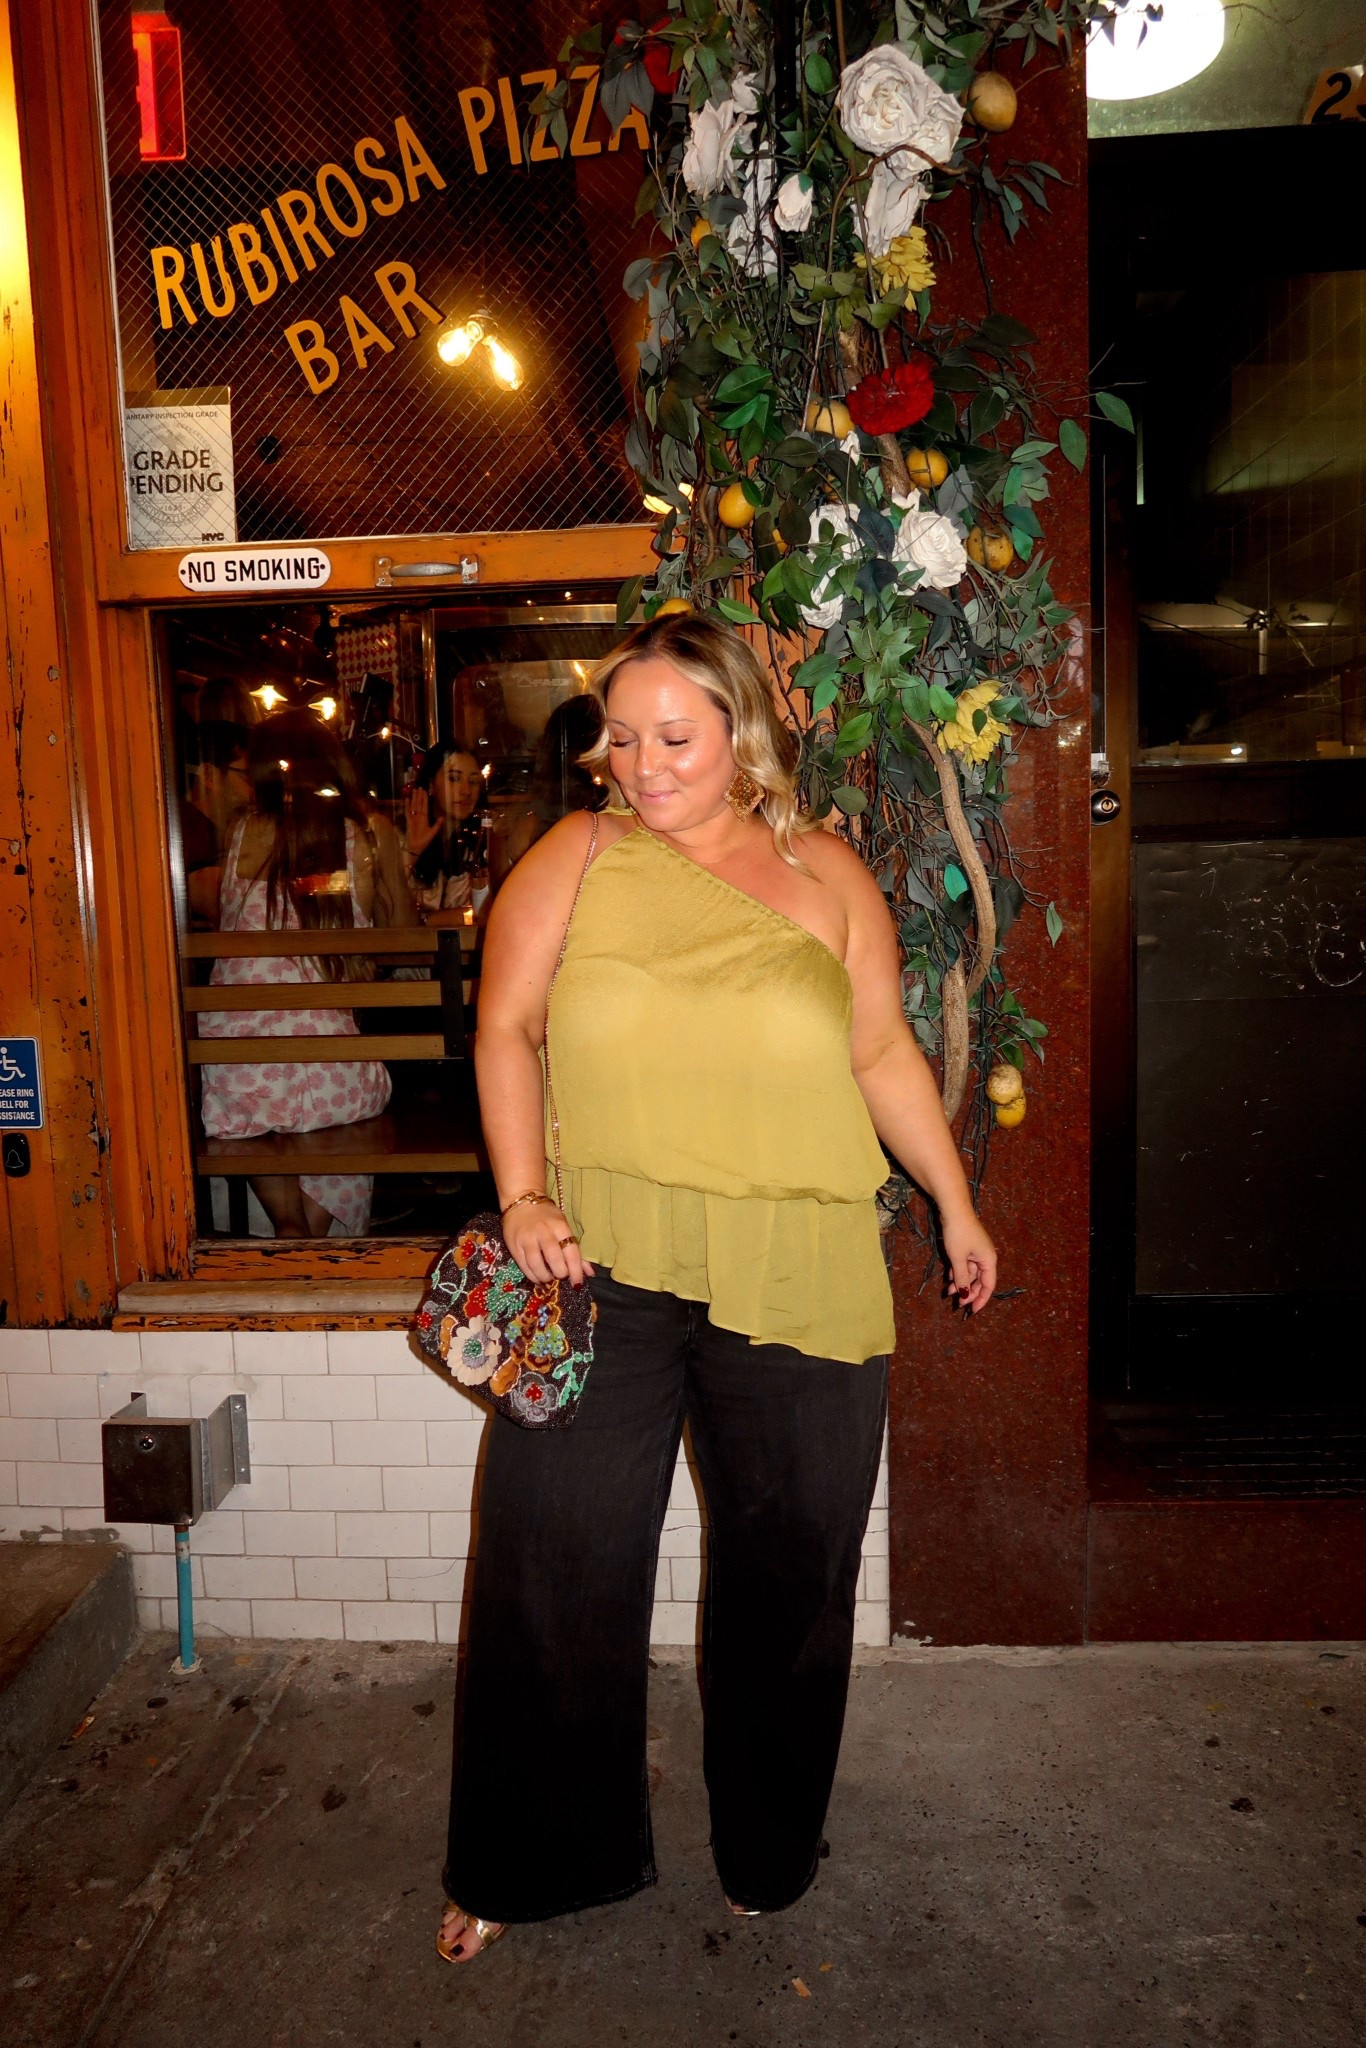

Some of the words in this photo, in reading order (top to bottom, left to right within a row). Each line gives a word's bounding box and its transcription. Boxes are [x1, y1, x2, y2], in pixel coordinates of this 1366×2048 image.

[1311, 72, 1366, 124] 2
[150, 115, 447, 329] RUBIROSA
[458, 65, 650, 175] PIZZA
[284, 261, 444, 395] BAR
[155, 412, 194, 420] INSPECTION
[133, 450, 211, 471] GRADE
[201, 532, 225, 542] NYC
[187, 561, 215, 583] NO
[225, 557, 320, 582] SMOKING
[16, 1088, 34, 1097] RING
[0, 1100, 14, 1109] ELL
[14, 1100, 29, 1109] FOR
